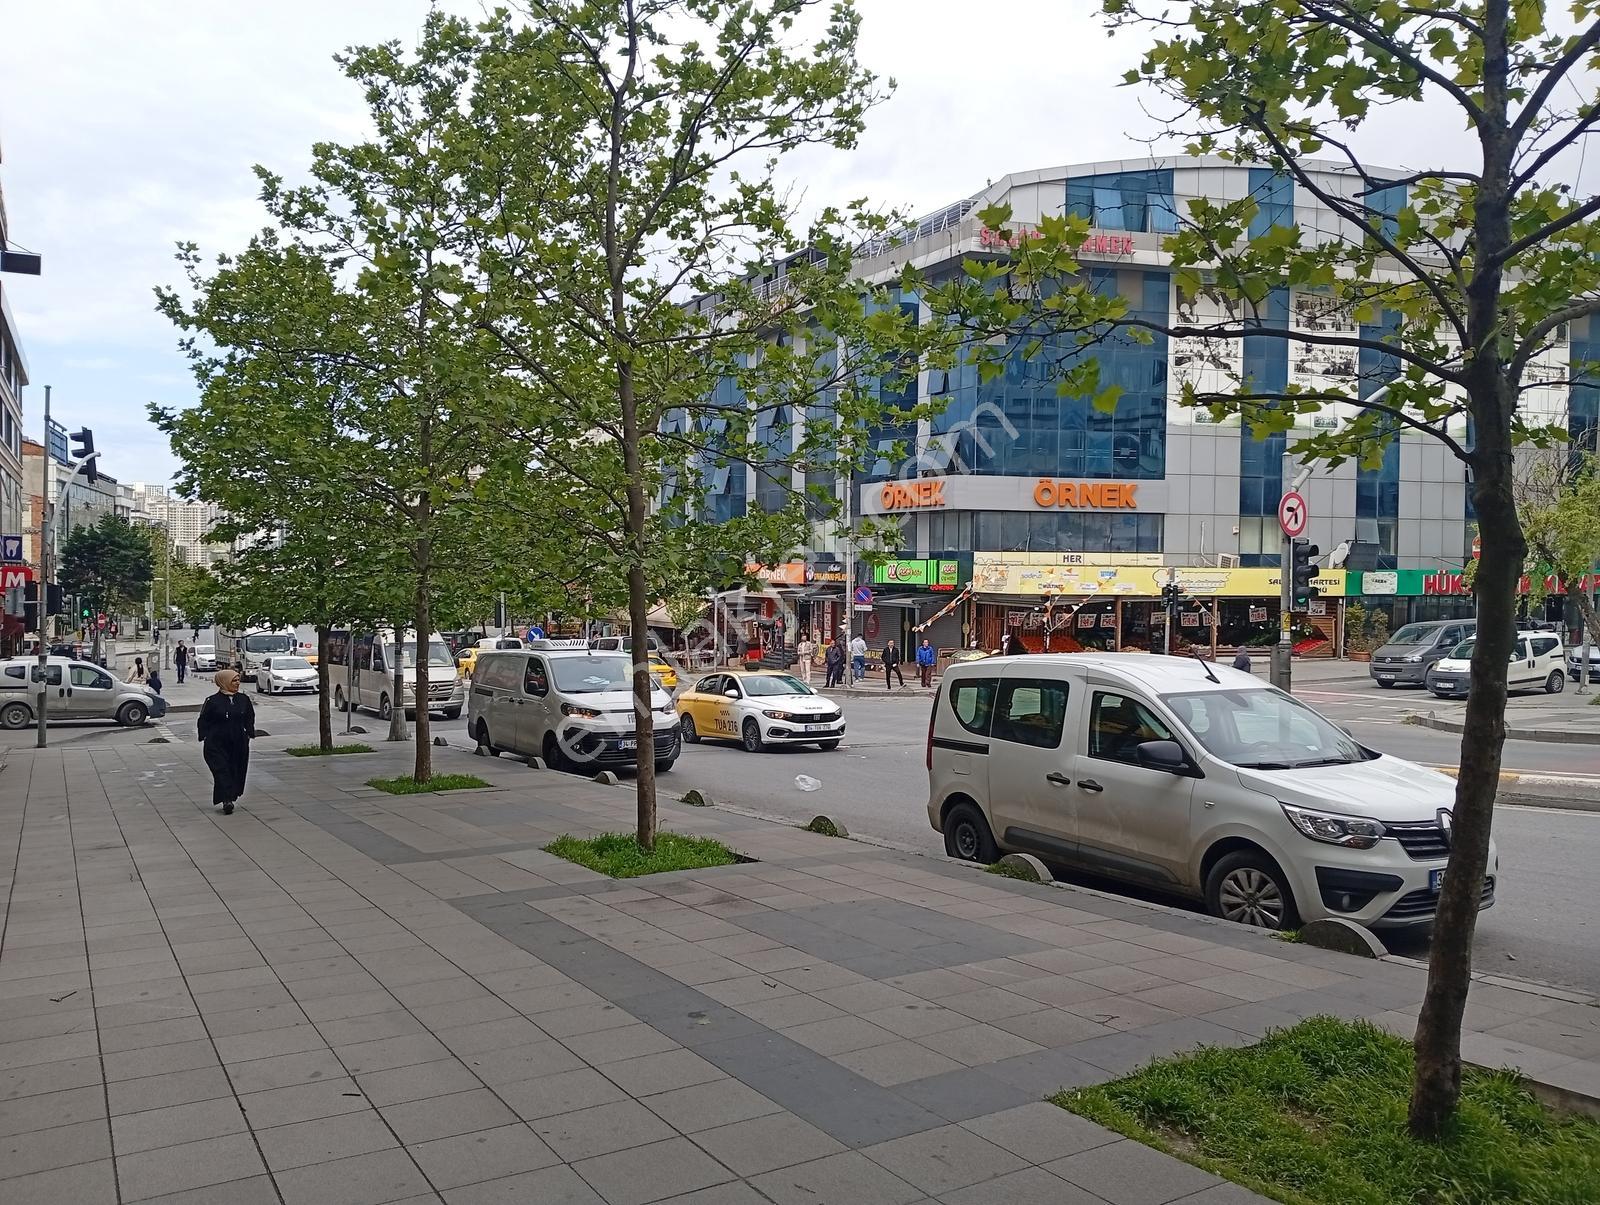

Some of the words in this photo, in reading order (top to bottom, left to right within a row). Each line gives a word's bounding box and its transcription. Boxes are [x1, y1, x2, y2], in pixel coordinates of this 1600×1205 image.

[881, 480, 946, 510] ÖRNEK
[1033, 479, 1138, 509] ÖRNEK
[1062, 554, 1082, 564] HER
[1308, 577, 1340, 586] ARTESİ
[714, 718, 727, 731] TUA
[727, 719, 739, 733] 276
